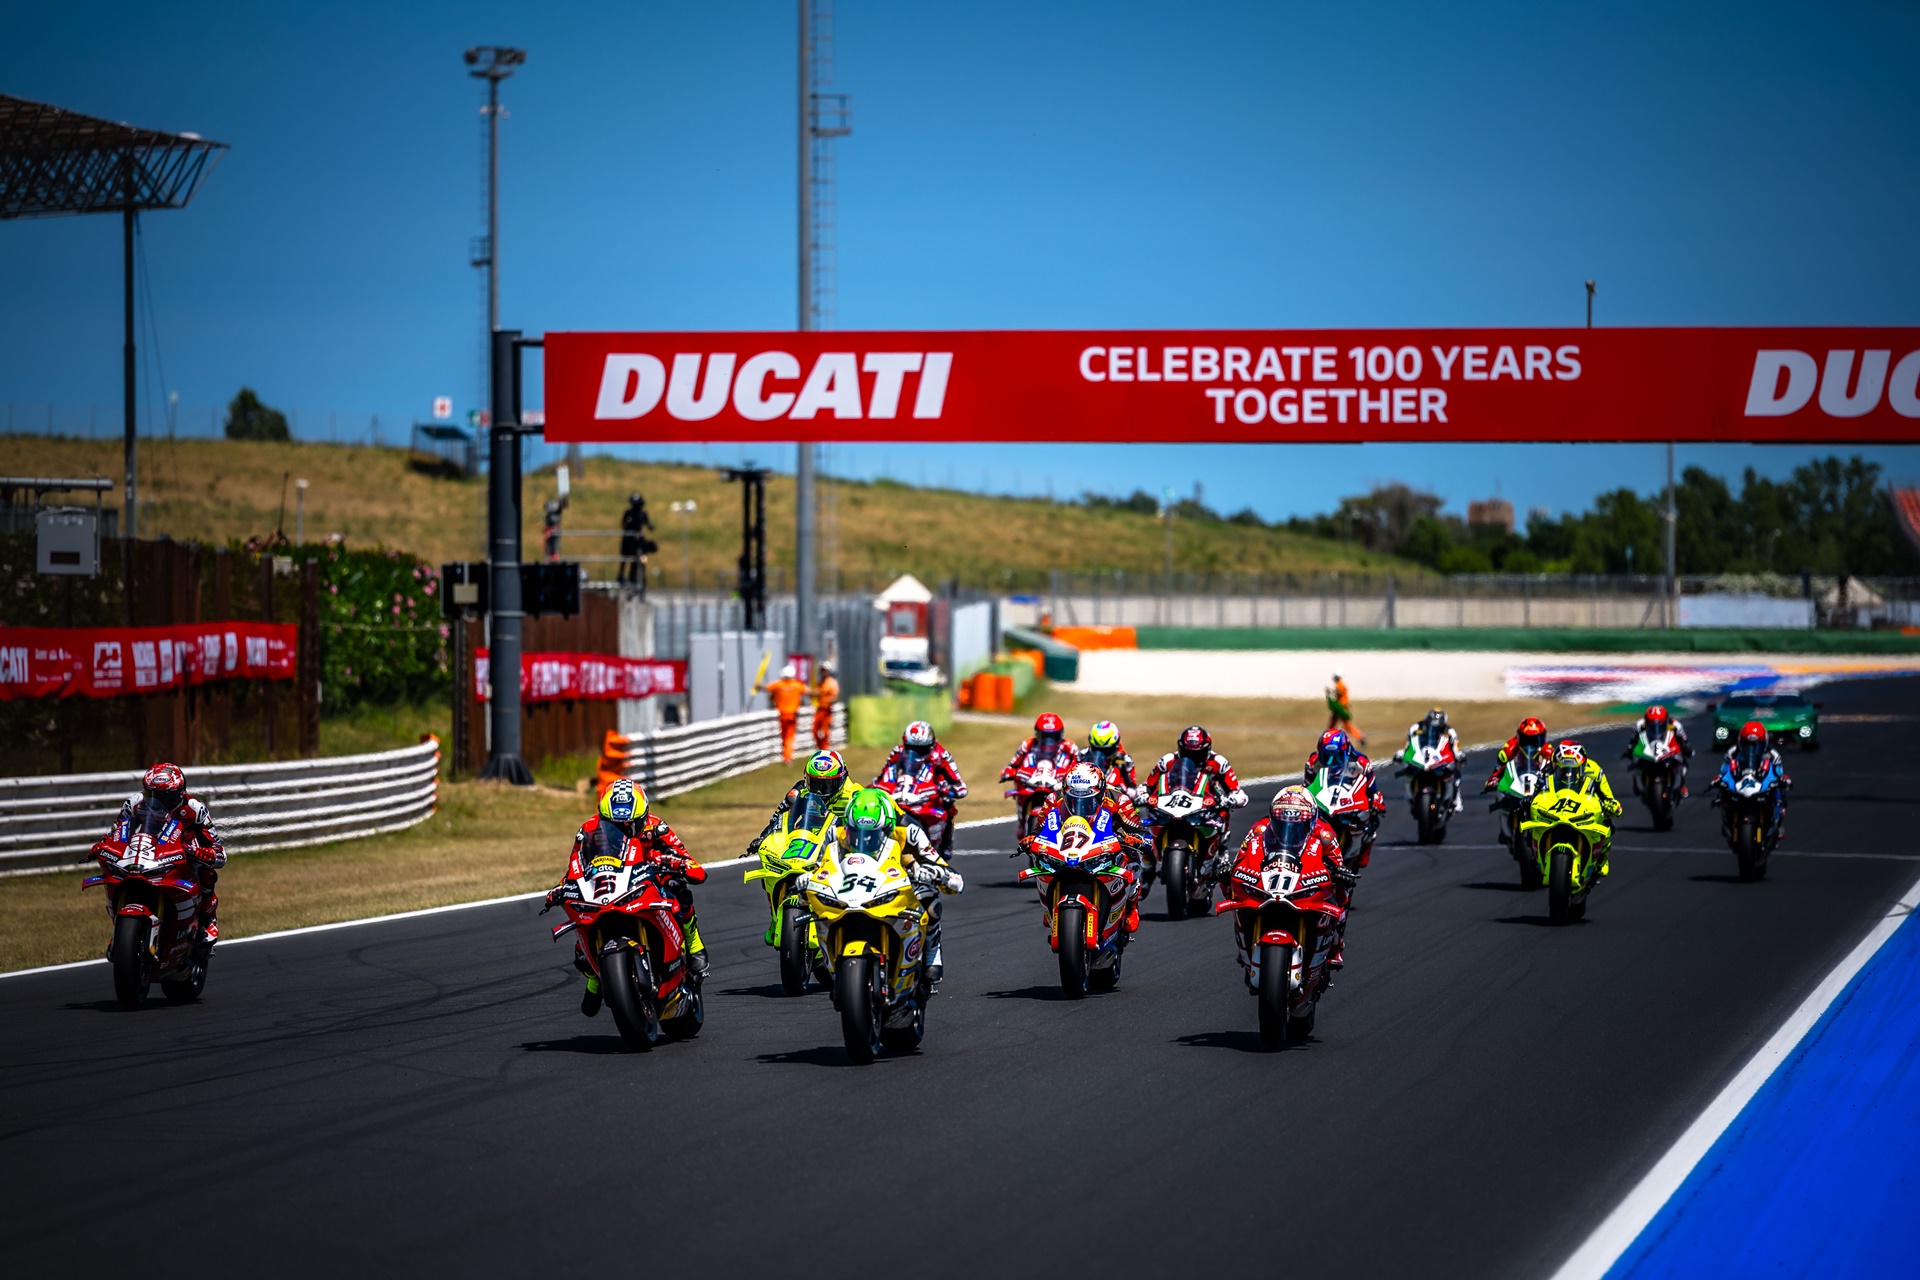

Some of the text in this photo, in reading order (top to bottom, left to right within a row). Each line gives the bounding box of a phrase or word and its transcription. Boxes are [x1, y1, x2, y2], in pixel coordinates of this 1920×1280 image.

[1079, 345, 1582, 382] CELEBRATE 100 YEARS
[594, 351, 953, 421] DUCATI
[1205, 388, 1448, 424] TOGETHER
[1548, 797, 1581, 813] 49
[781, 838, 818, 860] 21
[1060, 831, 1090, 851] 67
[100, 850, 119, 862] Lenovo
[1234, 870, 1257, 883] Lenovo
[1238, 866, 1261, 877] ALTEN
[1301, 868, 1327, 878] ALTEN
[838, 873, 876, 894] 34
[1268, 874, 1292, 891] 11
[1301, 875, 1328, 886] Lenovo
